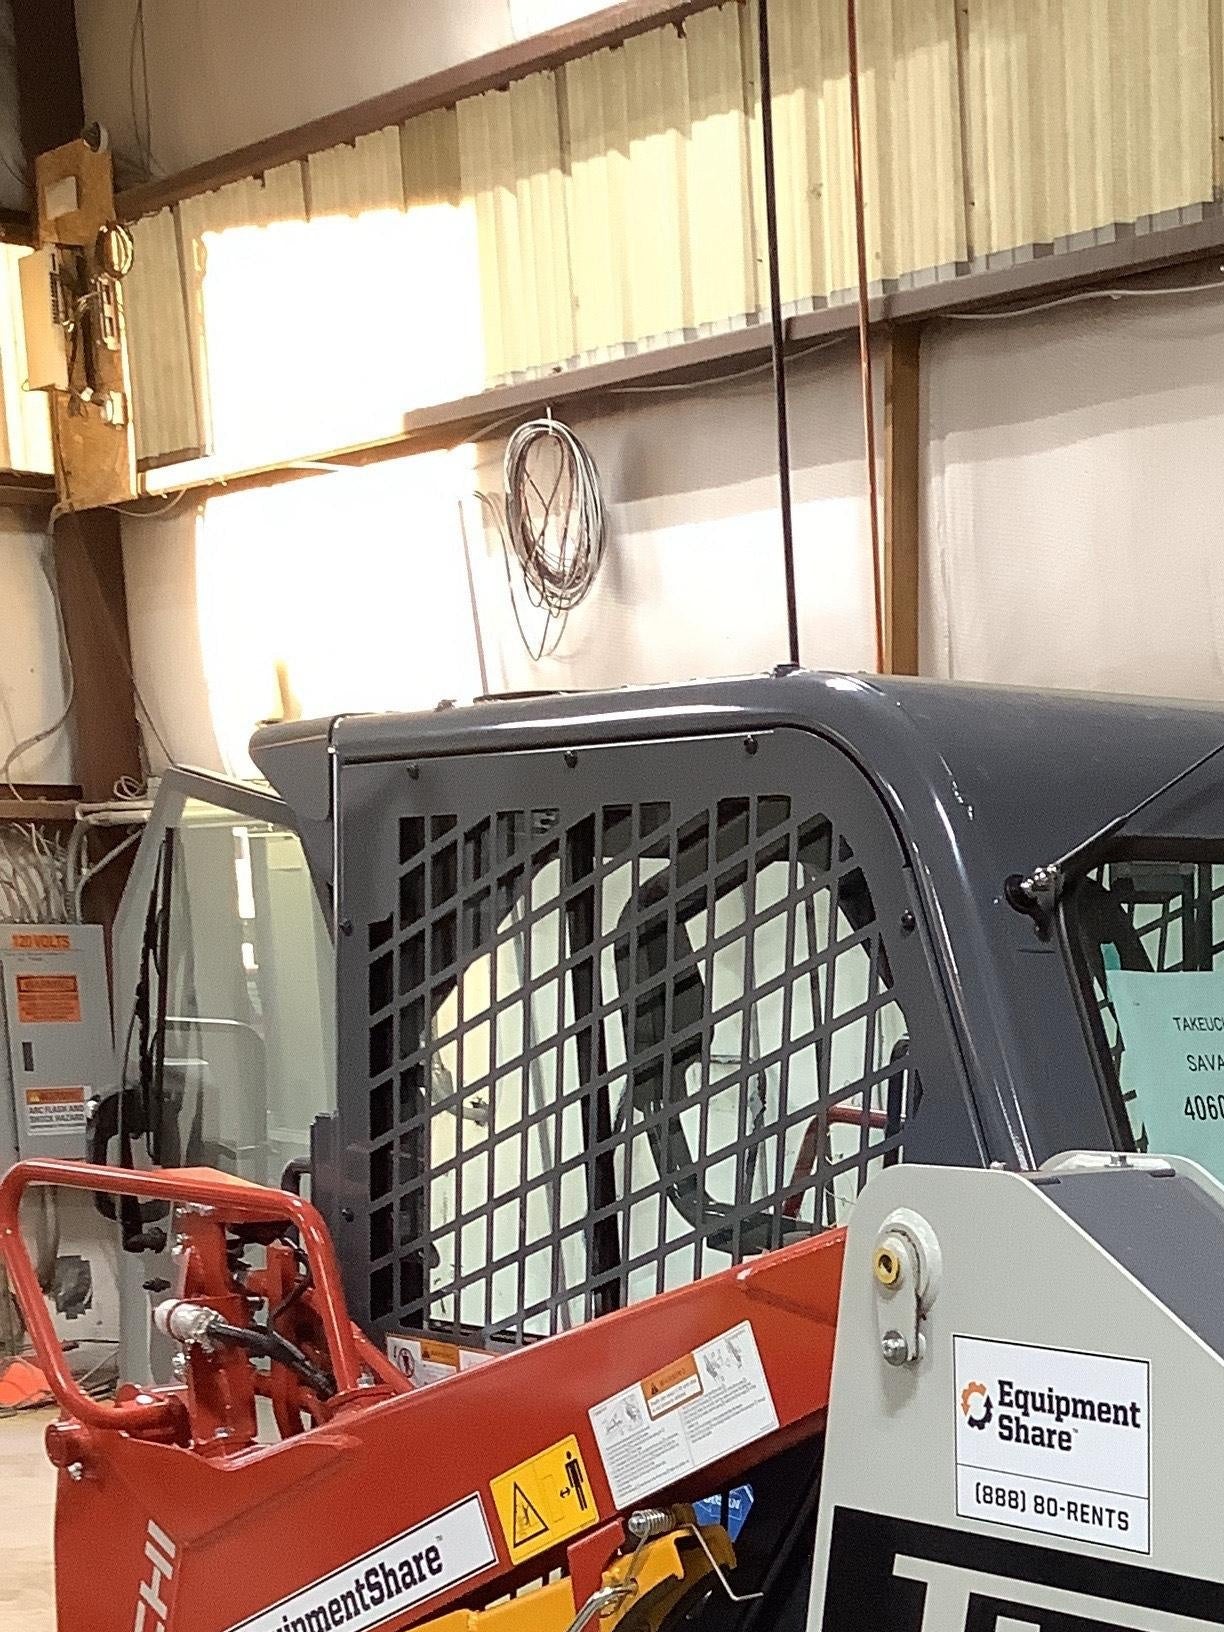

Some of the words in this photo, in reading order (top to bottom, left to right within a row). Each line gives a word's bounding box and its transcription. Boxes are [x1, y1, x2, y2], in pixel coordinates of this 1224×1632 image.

[998, 1379, 1141, 1429] Equipment
[998, 1414, 1072, 1452] Share
[975, 1482, 1026, 1513] (888)
[1033, 1494, 1129, 1531] 80-RENTS
